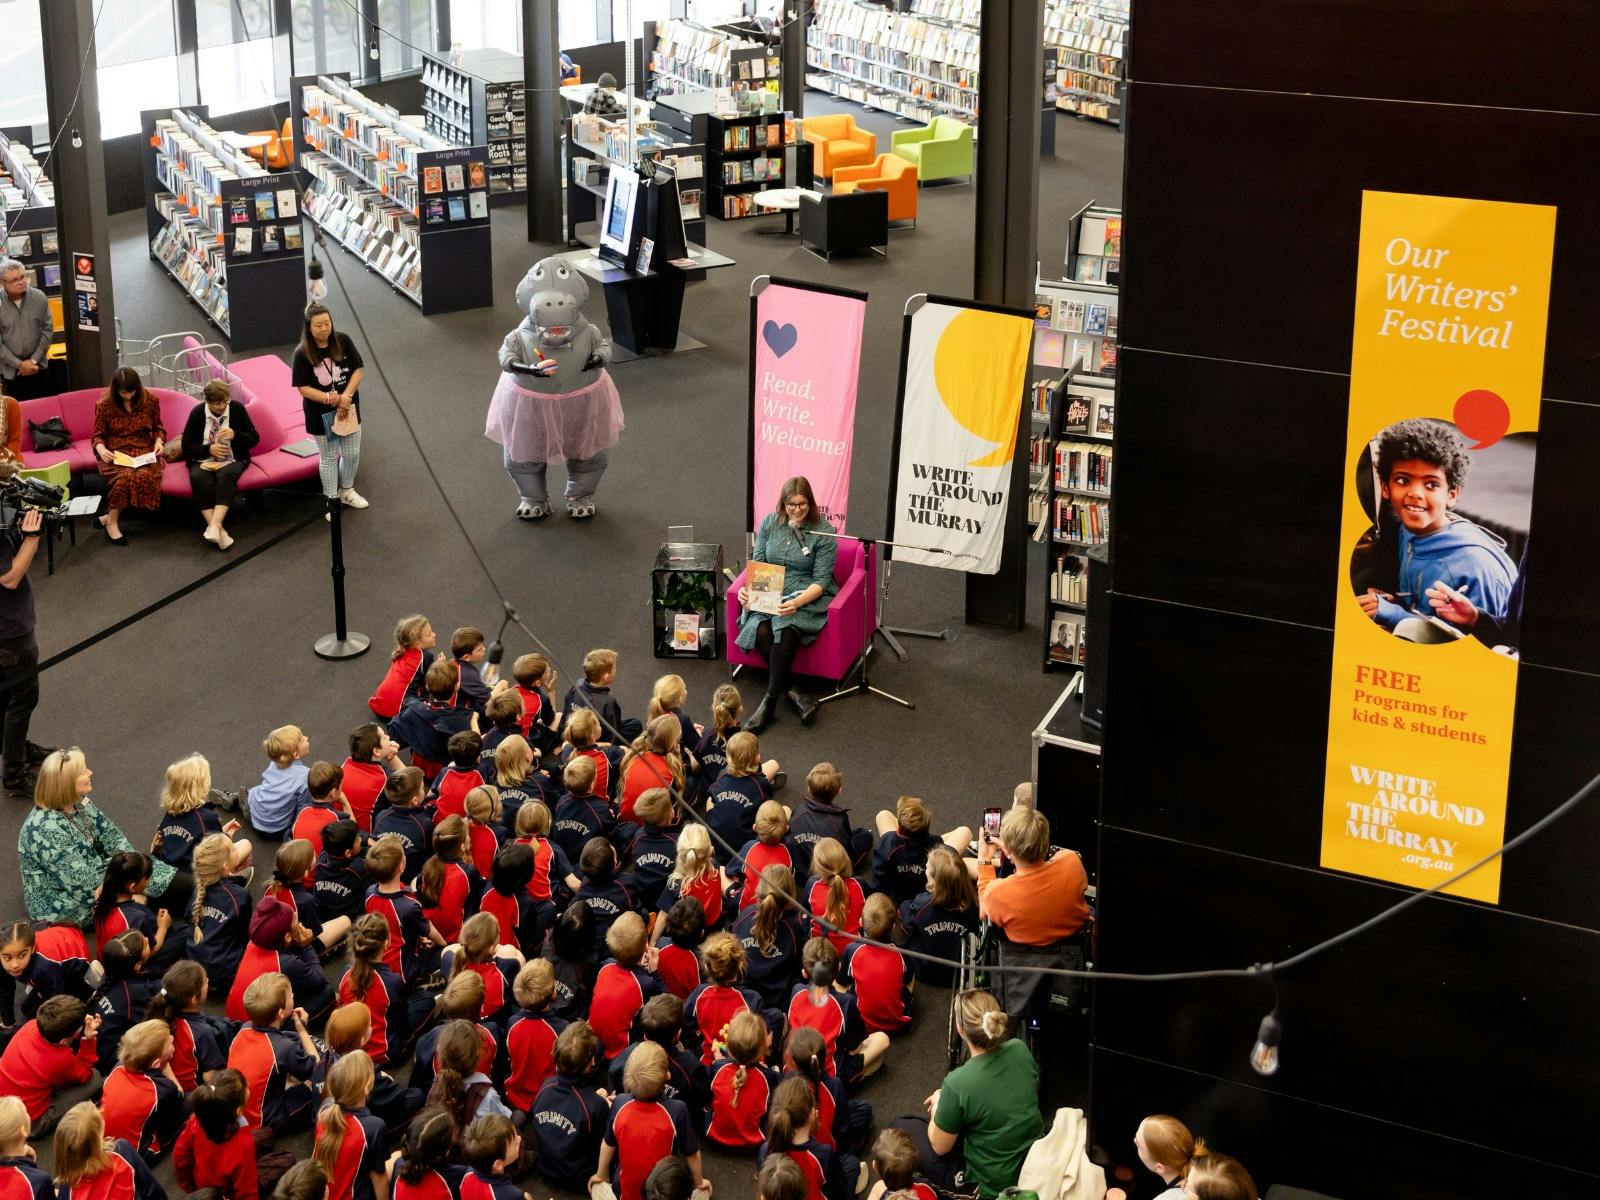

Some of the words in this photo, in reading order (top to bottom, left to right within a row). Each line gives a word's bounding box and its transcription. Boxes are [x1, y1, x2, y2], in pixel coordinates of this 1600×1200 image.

[490, 115, 505, 123] Good
[488, 143, 508, 152] Grass
[488, 150, 510, 159] Roots
[263, 176, 280, 184] Print
[1385, 237, 1450, 269] Our
[1378, 309, 1513, 349] Festival
[762, 371, 816, 400] Read.
[763, 396, 815, 427] Write.
[912, 463, 974, 487] WRITE
[908, 493, 945, 512] THE
[927, 481, 1003, 507] AROUND
[907, 508, 986, 534] MURRAY
[1355, 664, 1422, 694] FREE
[1354, 689, 1438, 716] Programs
[1442, 704, 1468, 722] for
[1352, 708, 1389, 727] kids
[1392, 715, 1406, 731] &
[1410, 720, 1487, 746] students
[1350, 764, 1437, 800] WRITE
[716, 790, 753, 808] TRINITY
[1372, 789, 1485, 827] AROUND
[1346, 801, 1397, 828] THE
[163, 825, 194, 842] TRINITY
[556, 819, 590, 836] TRINITY
[1345, 820, 1458, 857] MURRAY
[636, 852, 674, 868] TRINITY
[1401, 852, 1454, 872] .org.au
[315, 880, 352, 897] TRINITY
[924, 921, 968, 936] TRINITY
[535, 1110, 577, 1135] TRINITY
